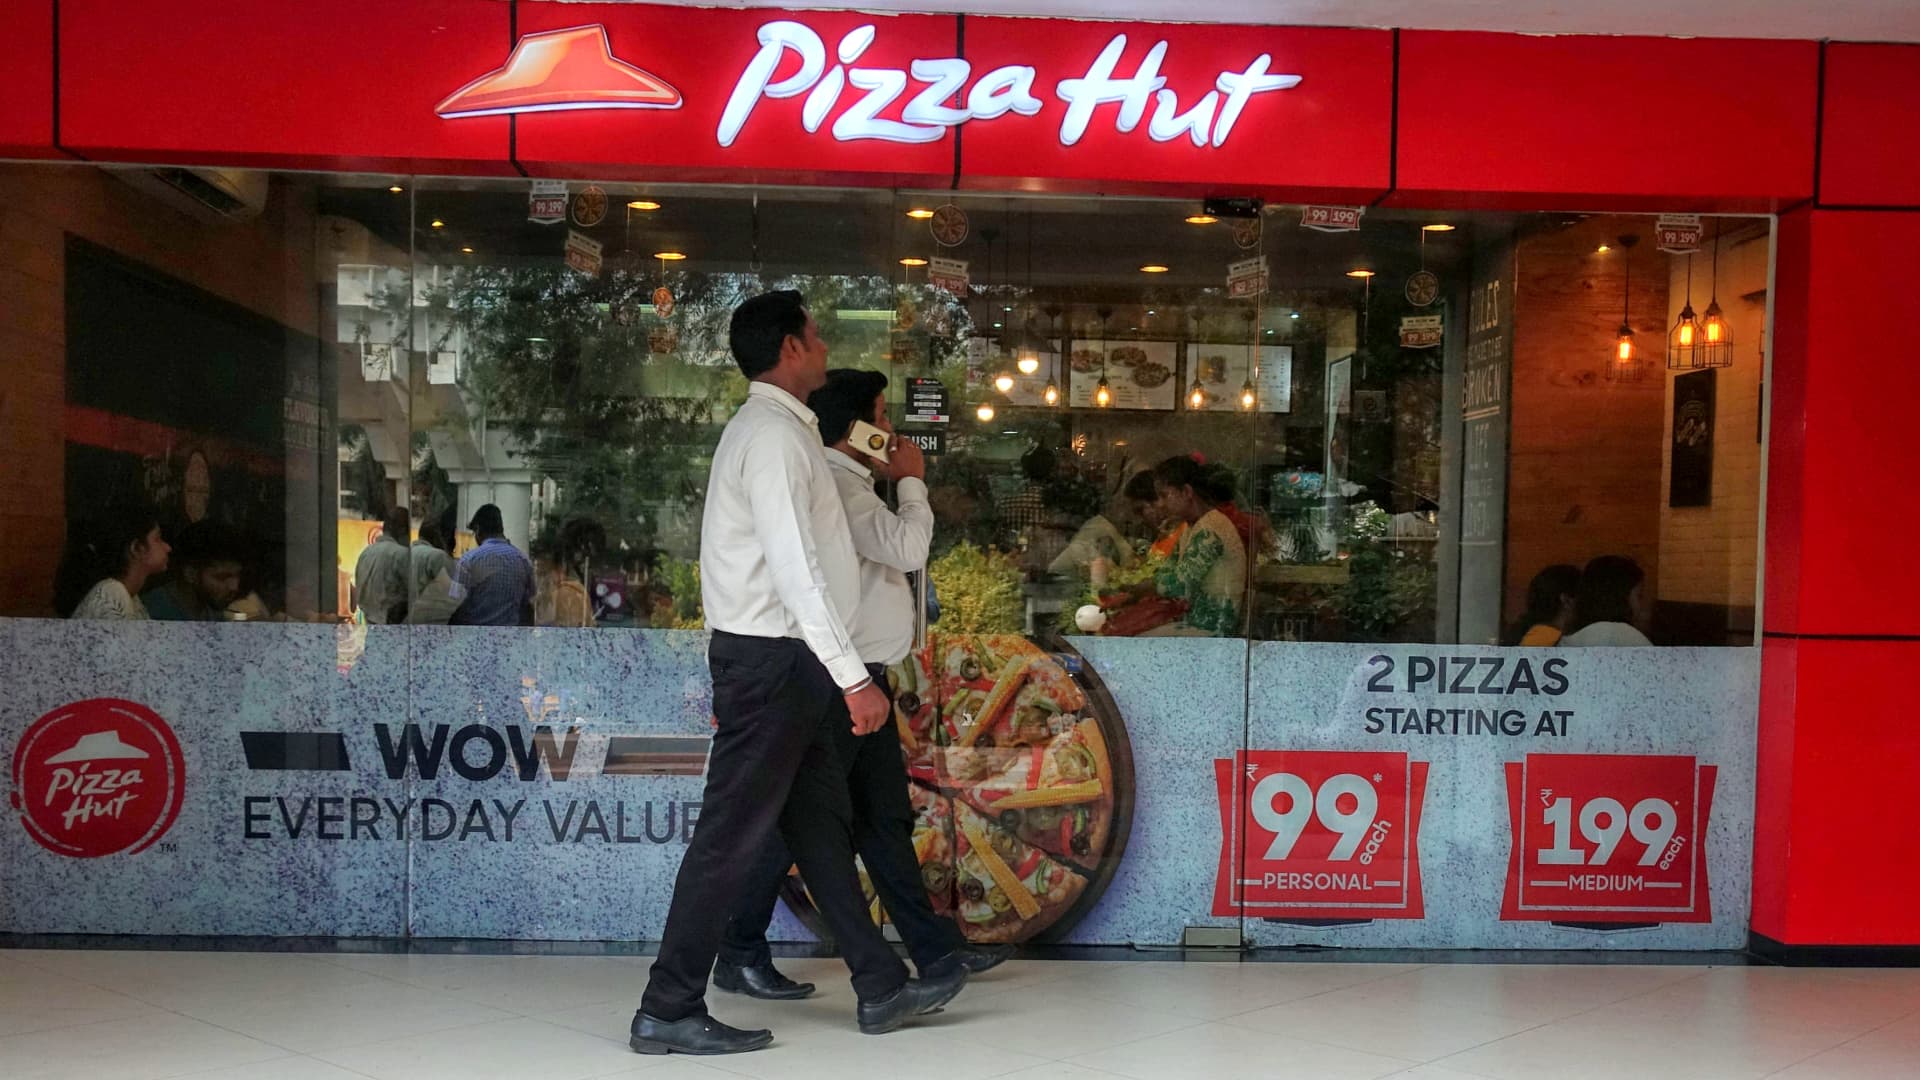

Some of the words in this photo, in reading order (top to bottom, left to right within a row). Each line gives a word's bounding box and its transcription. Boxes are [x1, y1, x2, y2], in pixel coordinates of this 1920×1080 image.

[716, 20, 1043, 147] Pizza
[1056, 33, 1303, 147] Hut
[535, 201, 546, 213] 99
[548, 201, 563, 213] 199
[1312, 209, 1328, 221] 99
[1333, 210, 1355, 222] 199
[1665, 232, 1676, 242] 99
[1680, 232, 1696, 243] 199
[1407, 333, 1419, 344] 99
[1462, 363, 1501, 409] BROKEN
[903, 435, 938, 450] USH
[1367, 655, 1395, 692] 2
[1407, 655, 1570, 696] PIZZAS
[1364, 707, 1527, 736] STARTING
[1533, 711, 1575, 737] AT
[373, 723, 581, 782] WOW
[45, 762, 144, 807] Pizza
[61, 791, 140, 830] Hut
[243, 796, 527, 843] EVERYDAY
[542, 799, 704, 844] VALUE
[160, 844, 177, 852] TM
[1359, 820, 1393, 865] each
[1659, 835, 1687, 871] each
[1263, 872, 1373, 891] PERSONAL
[1568, 875, 1643, 891] MEDIUM
